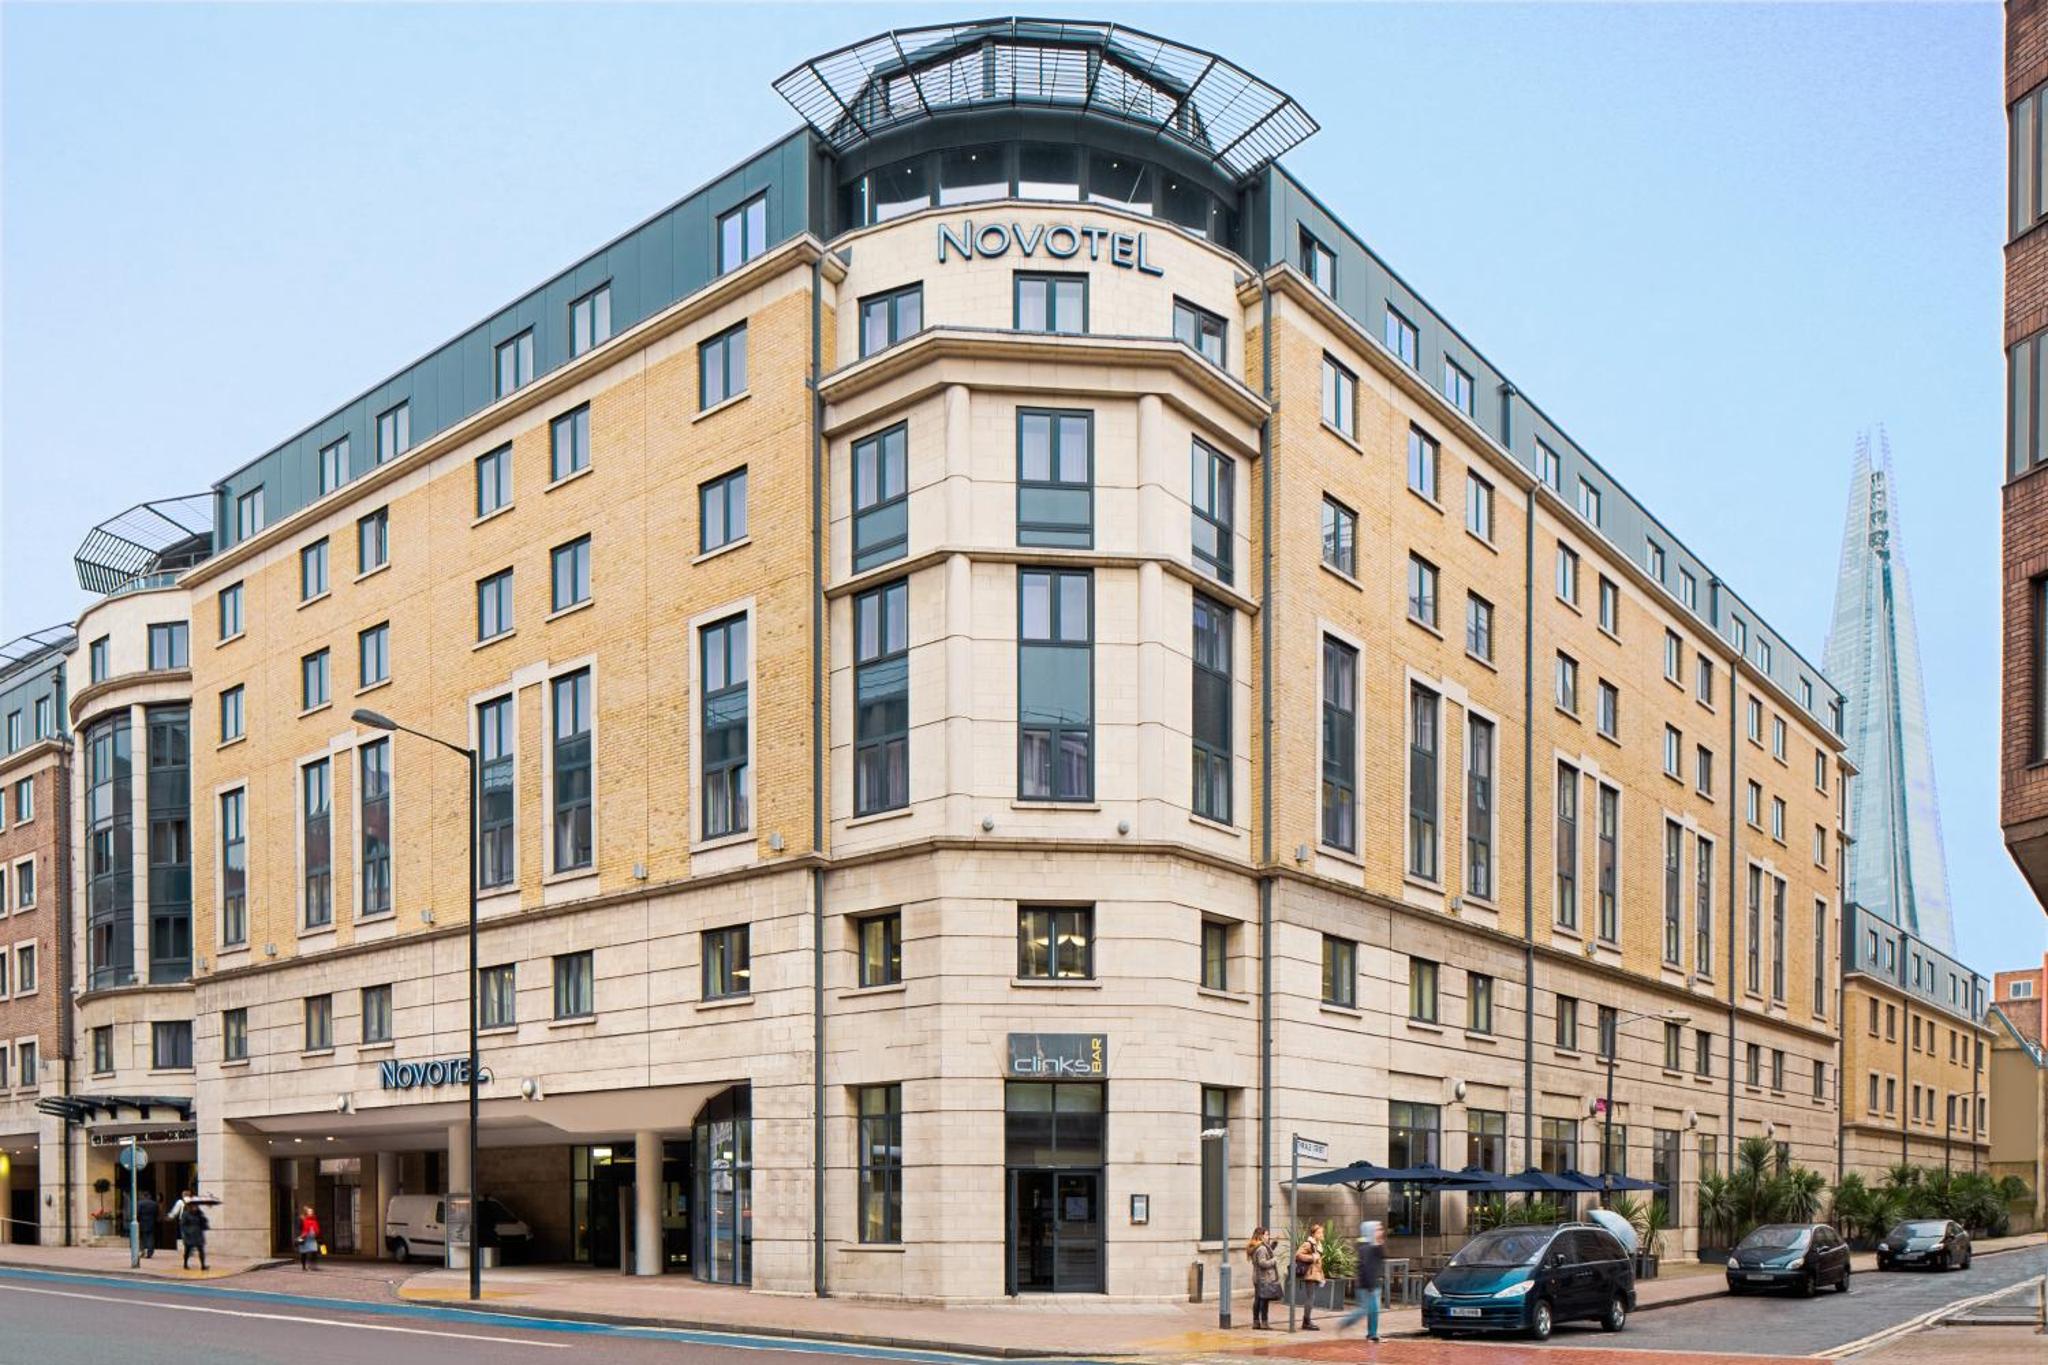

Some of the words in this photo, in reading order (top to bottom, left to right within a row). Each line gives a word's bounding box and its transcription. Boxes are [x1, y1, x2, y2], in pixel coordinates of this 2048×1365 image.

[938, 219, 1164, 277] NOVOTEL
[1014, 1055, 1091, 1073] clinks
[1091, 1038, 1102, 1073] BAR
